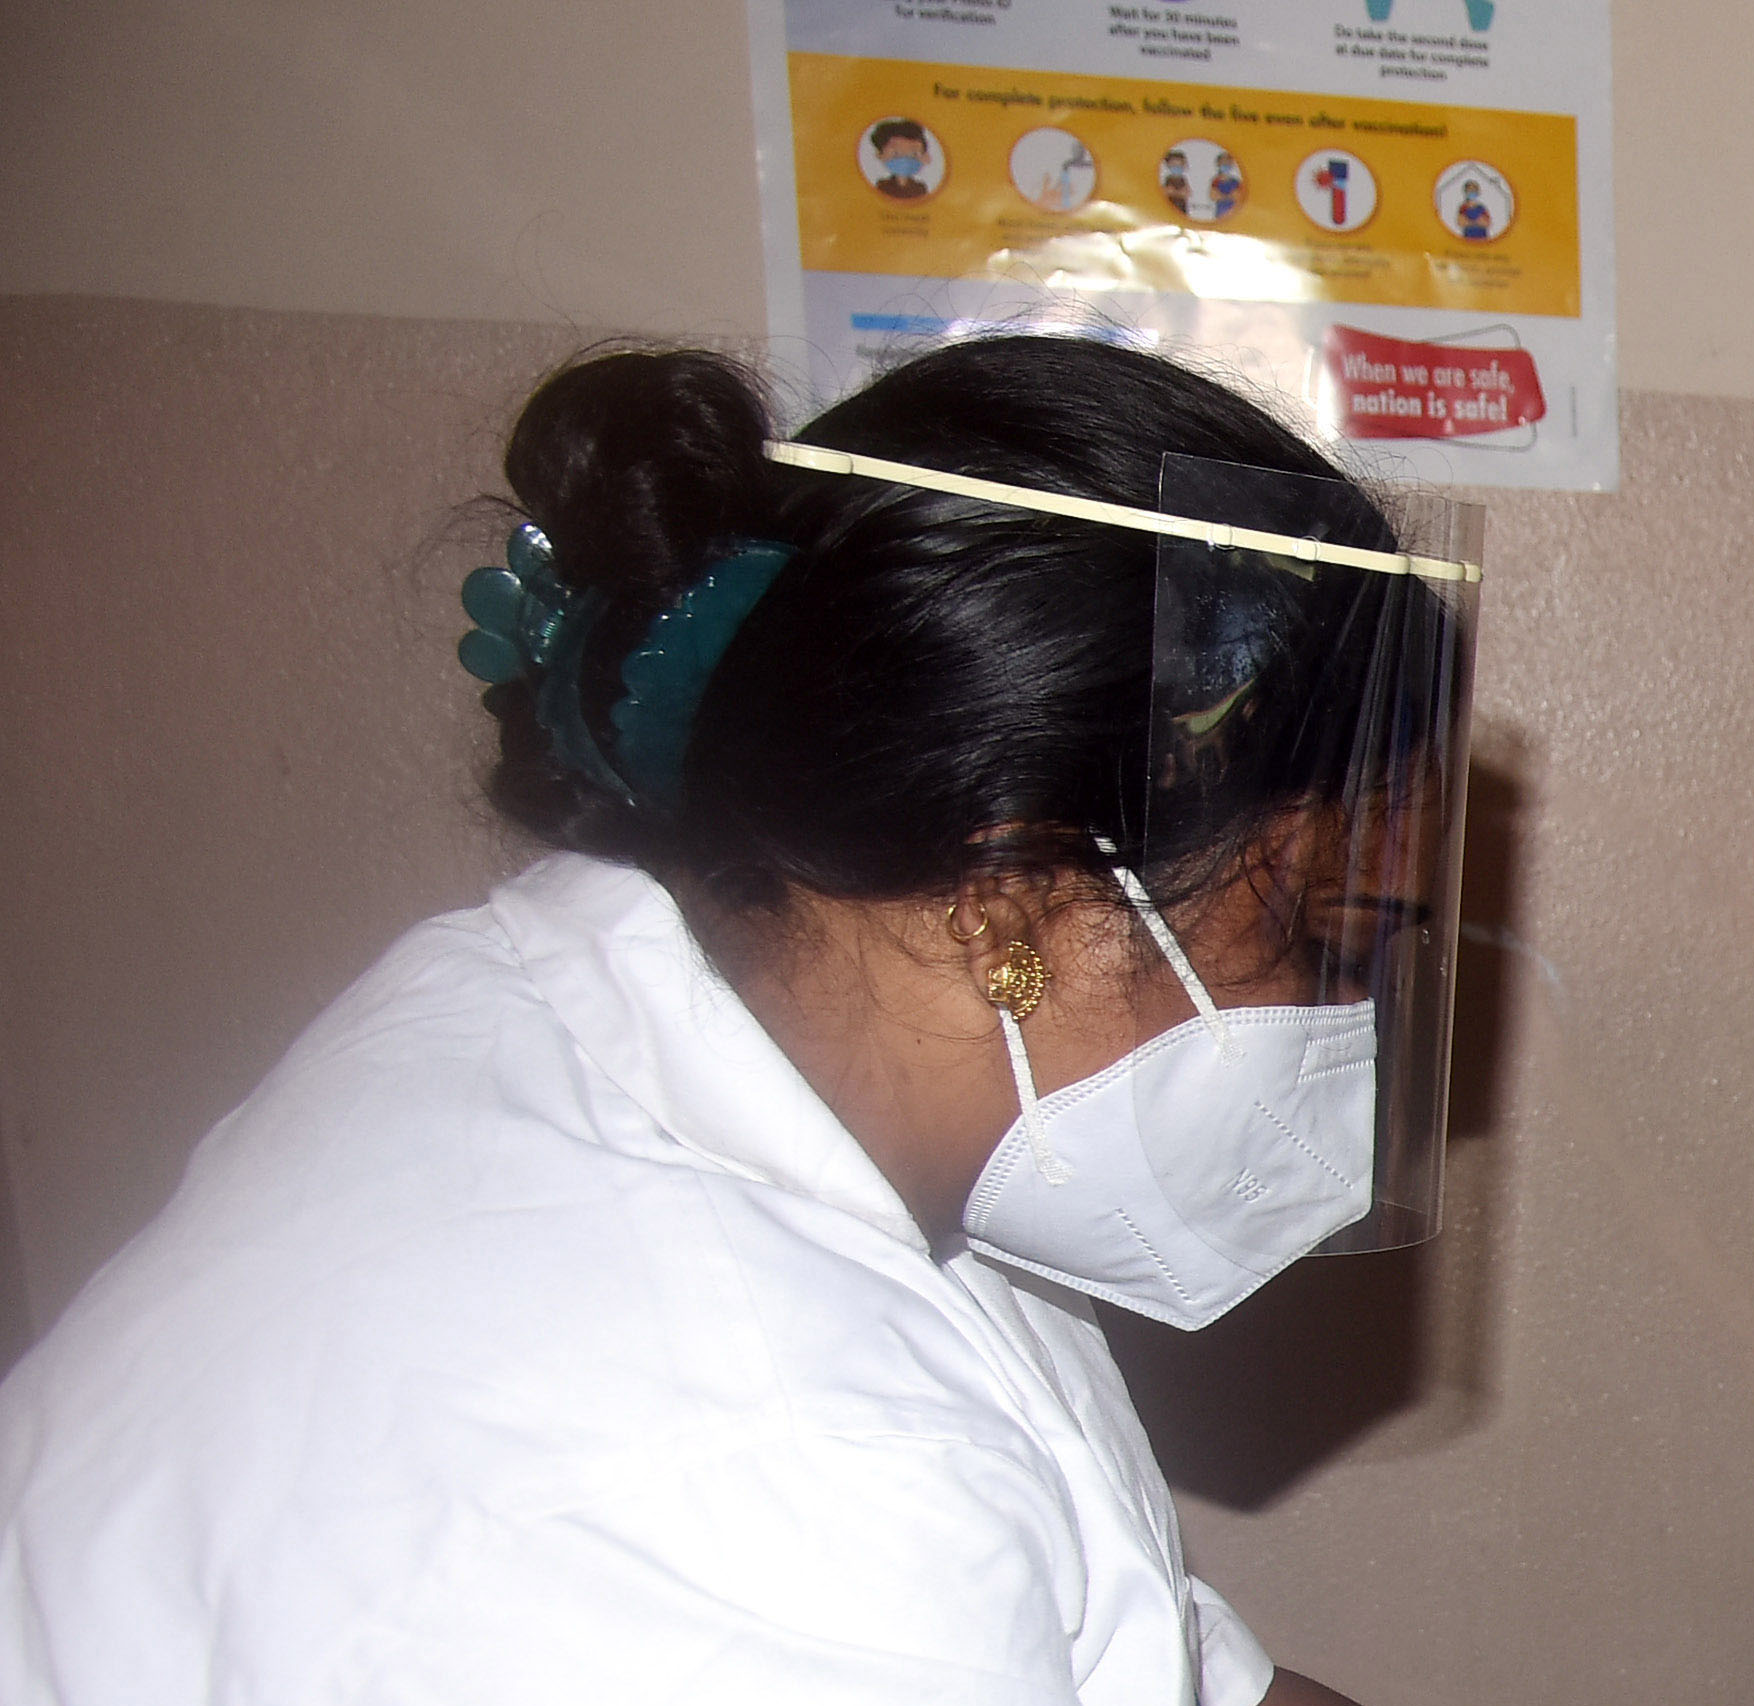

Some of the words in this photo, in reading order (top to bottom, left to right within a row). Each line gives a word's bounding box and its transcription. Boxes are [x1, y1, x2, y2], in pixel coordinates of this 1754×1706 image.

[918, 6, 996, 25] verification
[1109, 5, 1135, 20] Wait
[1139, 8, 1160, 21] for
[1165, 9, 1181, 23] 30
[1185, 11, 1238, 29] minutes
[1109, 24, 1141, 38] after
[1144, 28, 1170, 43] you
[1173, 28, 1202, 43] have
[1206, 31, 1240, 46] been
[1334, 24, 1352, 38] Do
[1357, 25, 1383, 40] take
[1388, 28, 1407, 42] the
[1410, 30, 1455, 48] second
[1460, 34, 1489, 50] dose
[1141, 43, 1212, 62] vaccinated
[1335, 44, 1348, 56] at
[1351, 44, 1375, 58] due
[1378, 47, 1405, 61] date
[1409, 49, 1427, 63] for
[1430, 51, 1489, 69] complete
[1379, 62, 1448, 82] protection
[933, 81, 960, 99] For
[966, 87, 1042, 108] complete
[1047, 95, 1135, 115] protection,
[1143, 98, 1193, 118] follow
[1200, 101, 1226, 121] the
[1230, 103, 1260, 124] five
[1265, 110, 1303, 127] even
[1308, 110, 1346, 130] after
[1343, 352, 1397, 384] When
[1401, 363, 1430, 387] we
[1432, 366, 1466, 389] are
[1469, 359, 1516, 394] safe,
[1352, 388, 1423, 418] nation
[1427, 390, 1447, 419] is
[1454, 392, 1510, 423] safe!
[1221, 1166, 1270, 1204] N95
